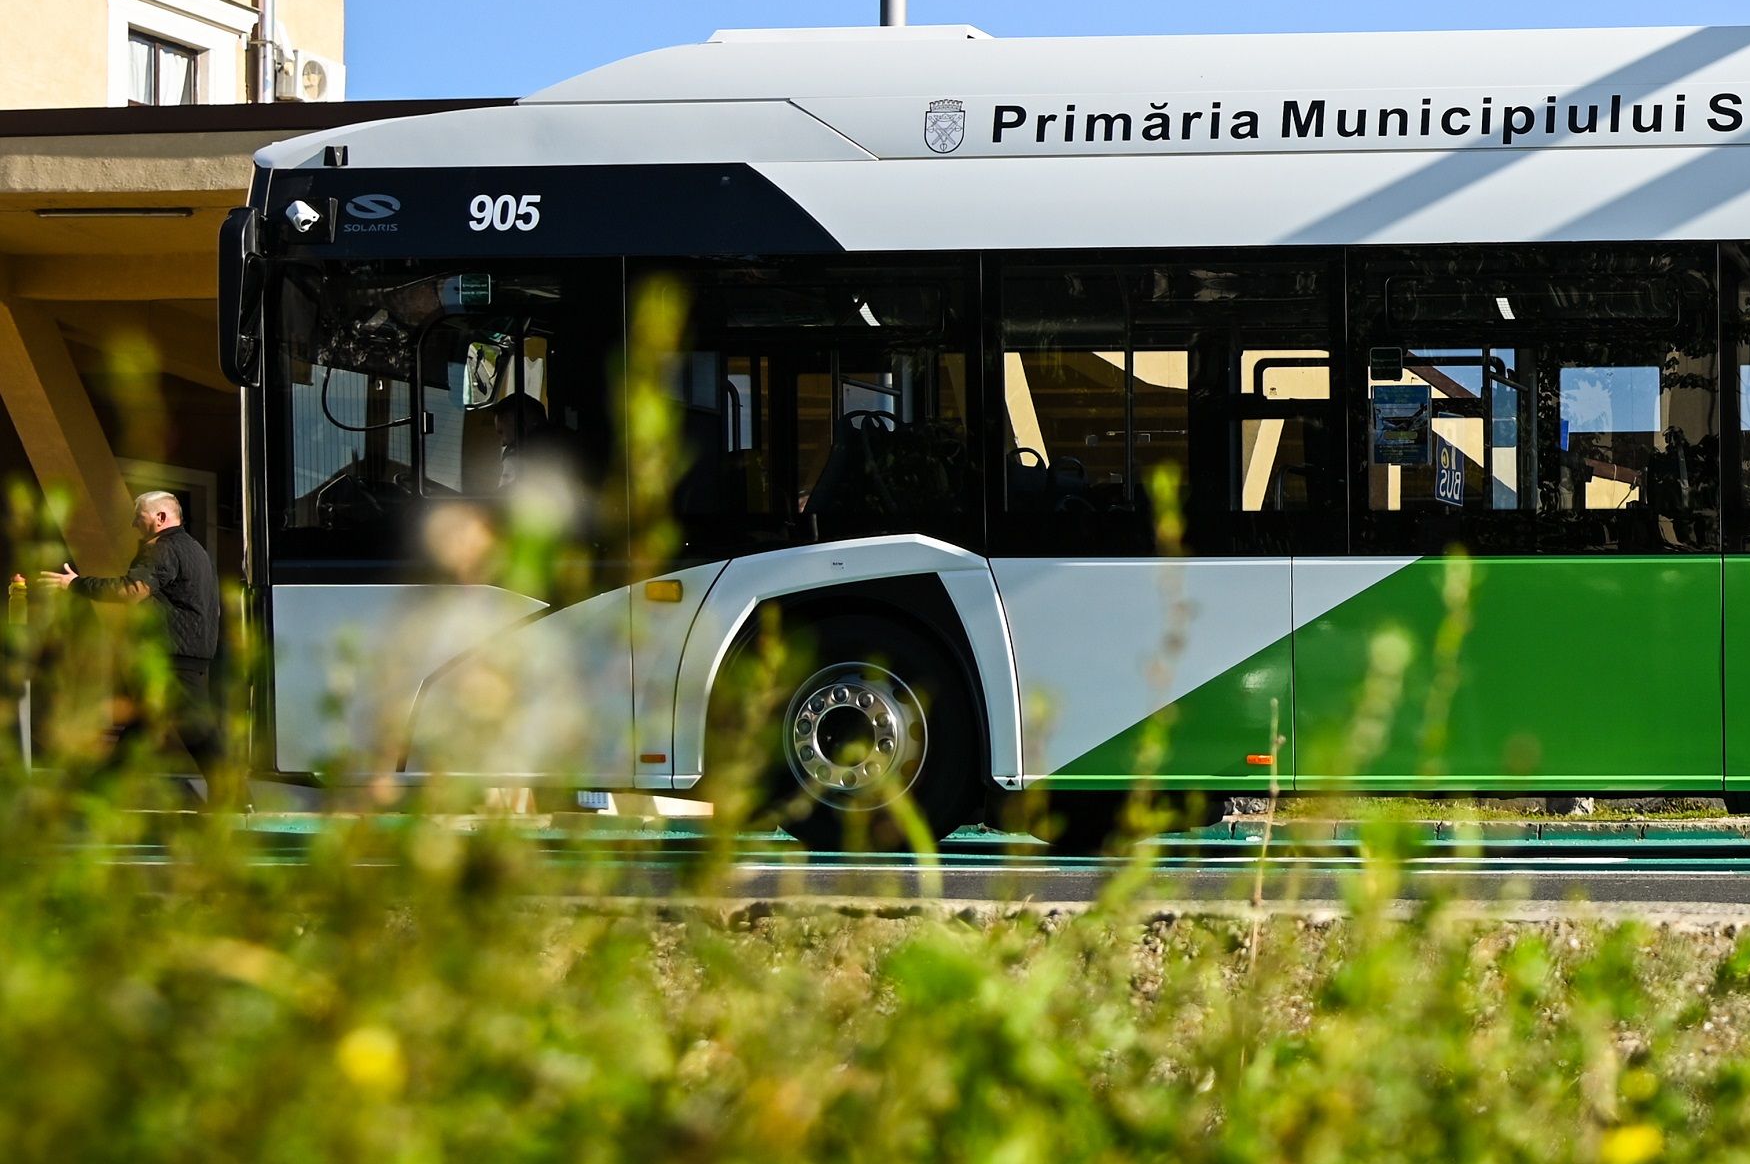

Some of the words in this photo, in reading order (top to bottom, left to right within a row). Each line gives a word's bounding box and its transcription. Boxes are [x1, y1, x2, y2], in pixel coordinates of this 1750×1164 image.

[991, 101, 1259, 143] Primăria
[1280, 93, 1686, 144] Municipiului
[343, 223, 399, 232] SOLARIS
[468, 194, 542, 232] 905
